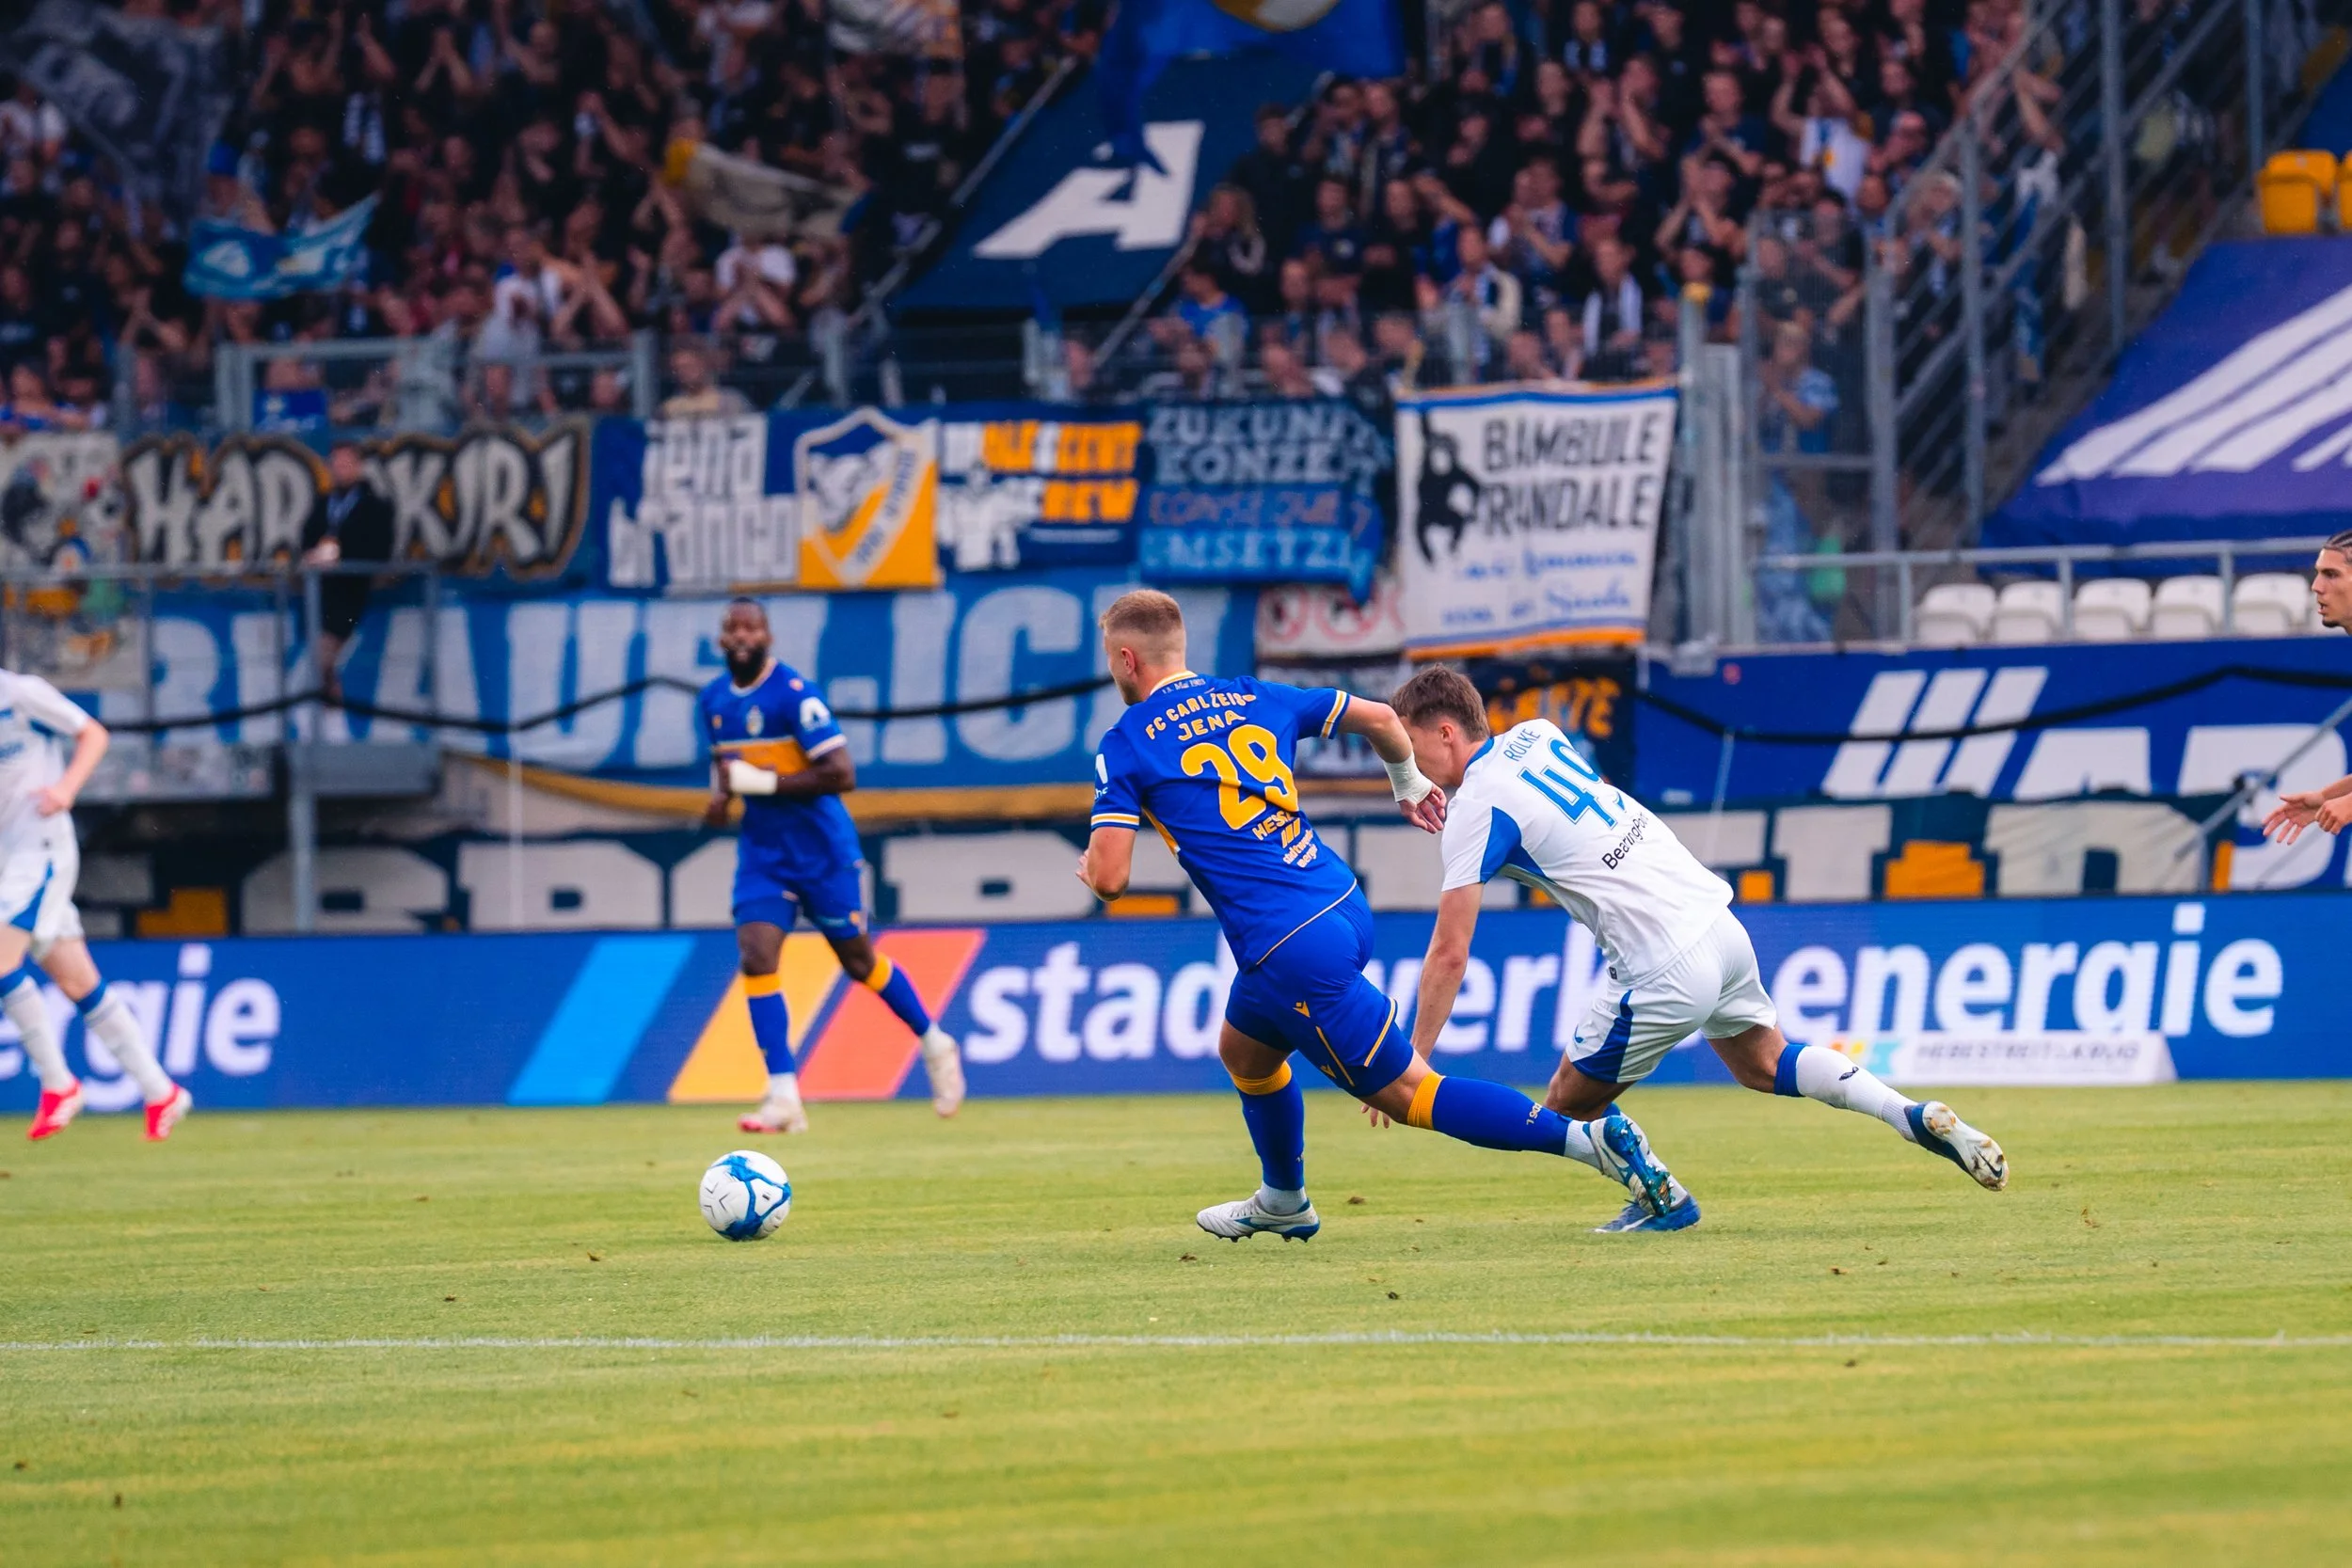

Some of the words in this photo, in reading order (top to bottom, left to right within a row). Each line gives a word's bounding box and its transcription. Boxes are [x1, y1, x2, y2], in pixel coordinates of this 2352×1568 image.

[1483, 411, 1661, 472] BAMBULE
[1483, 474, 1659, 536] RANDALE
[1145, 716, 1167, 740] FC
[1166, 695, 1211, 721] CARL
[1178, 710, 1247, 741] JENA
[1503, 728, 1541, 762] RÖLKE
[1180, 723, 1299, 831] 29
[1517, 736, 1627, 831] 49
[1772, 902, 2283, 1040] energie
